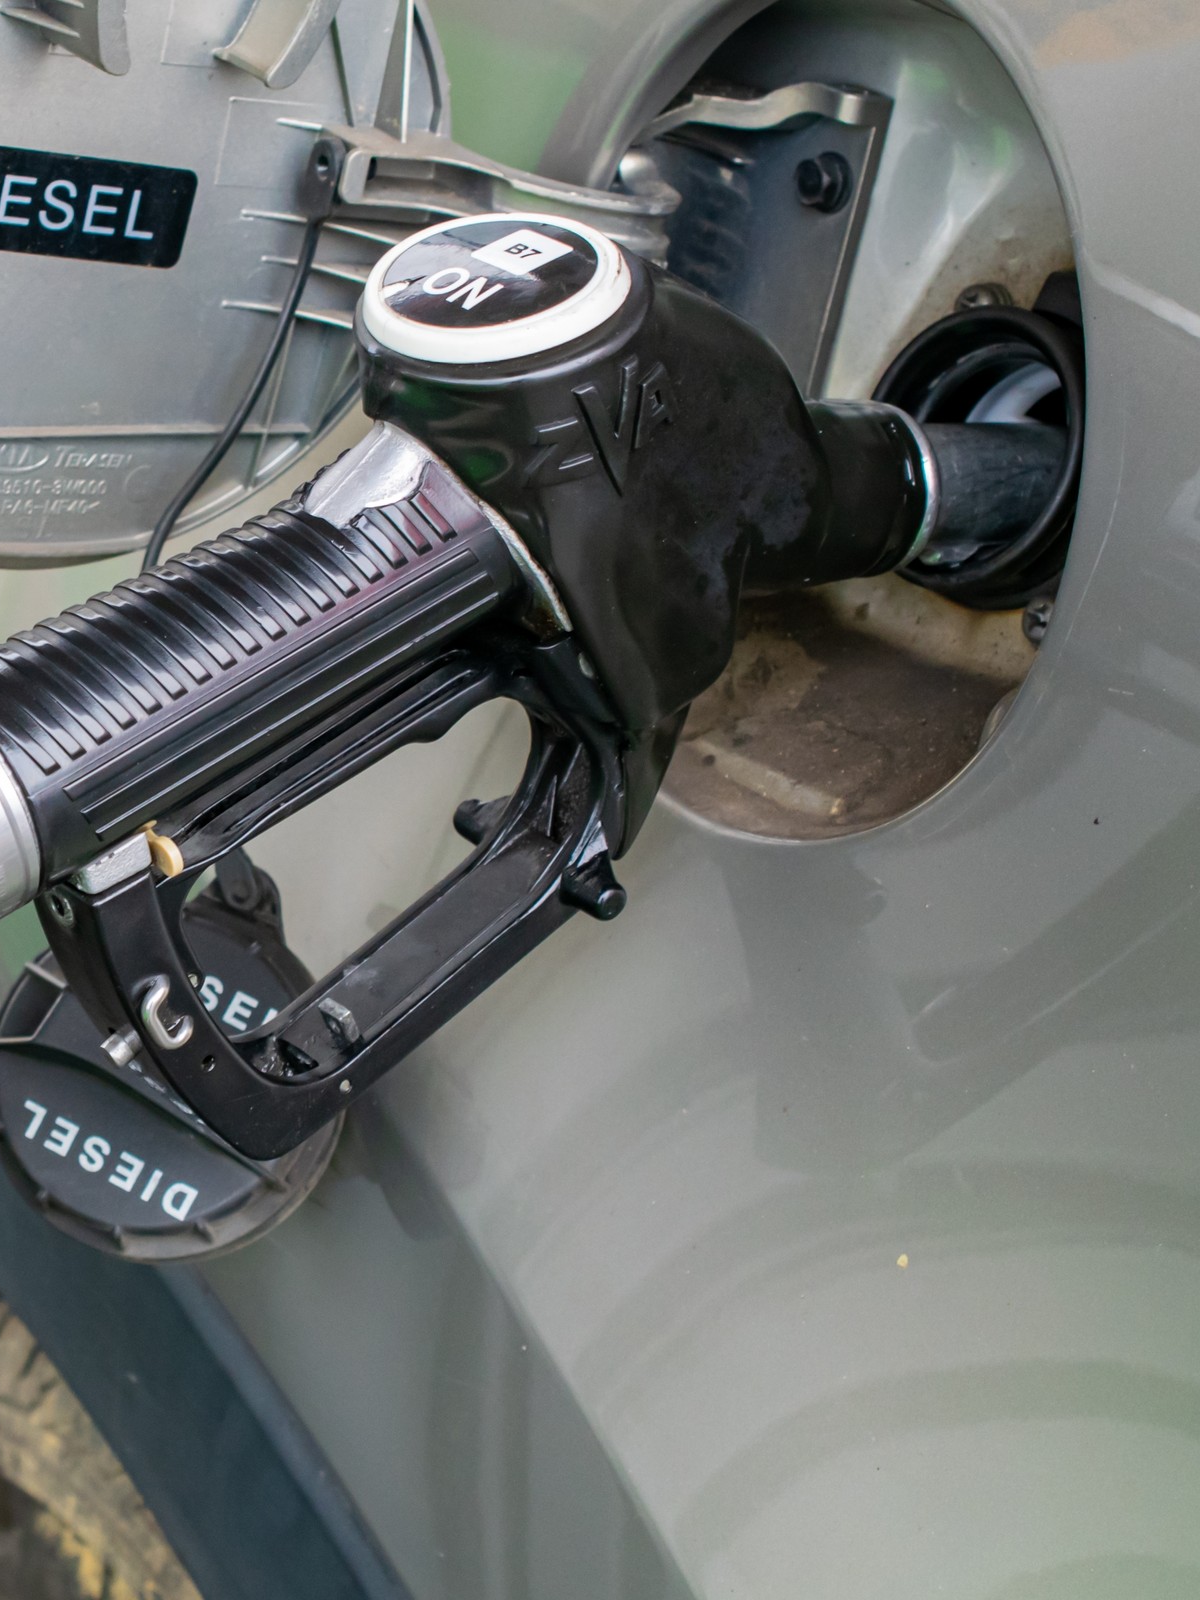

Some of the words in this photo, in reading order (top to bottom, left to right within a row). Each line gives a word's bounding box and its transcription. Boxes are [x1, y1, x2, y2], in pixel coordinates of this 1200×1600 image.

[504, 242, 542, 260] B7
[422, 266, 504, 311] ON
[23, 1099, 199, 1222] DIESEL
